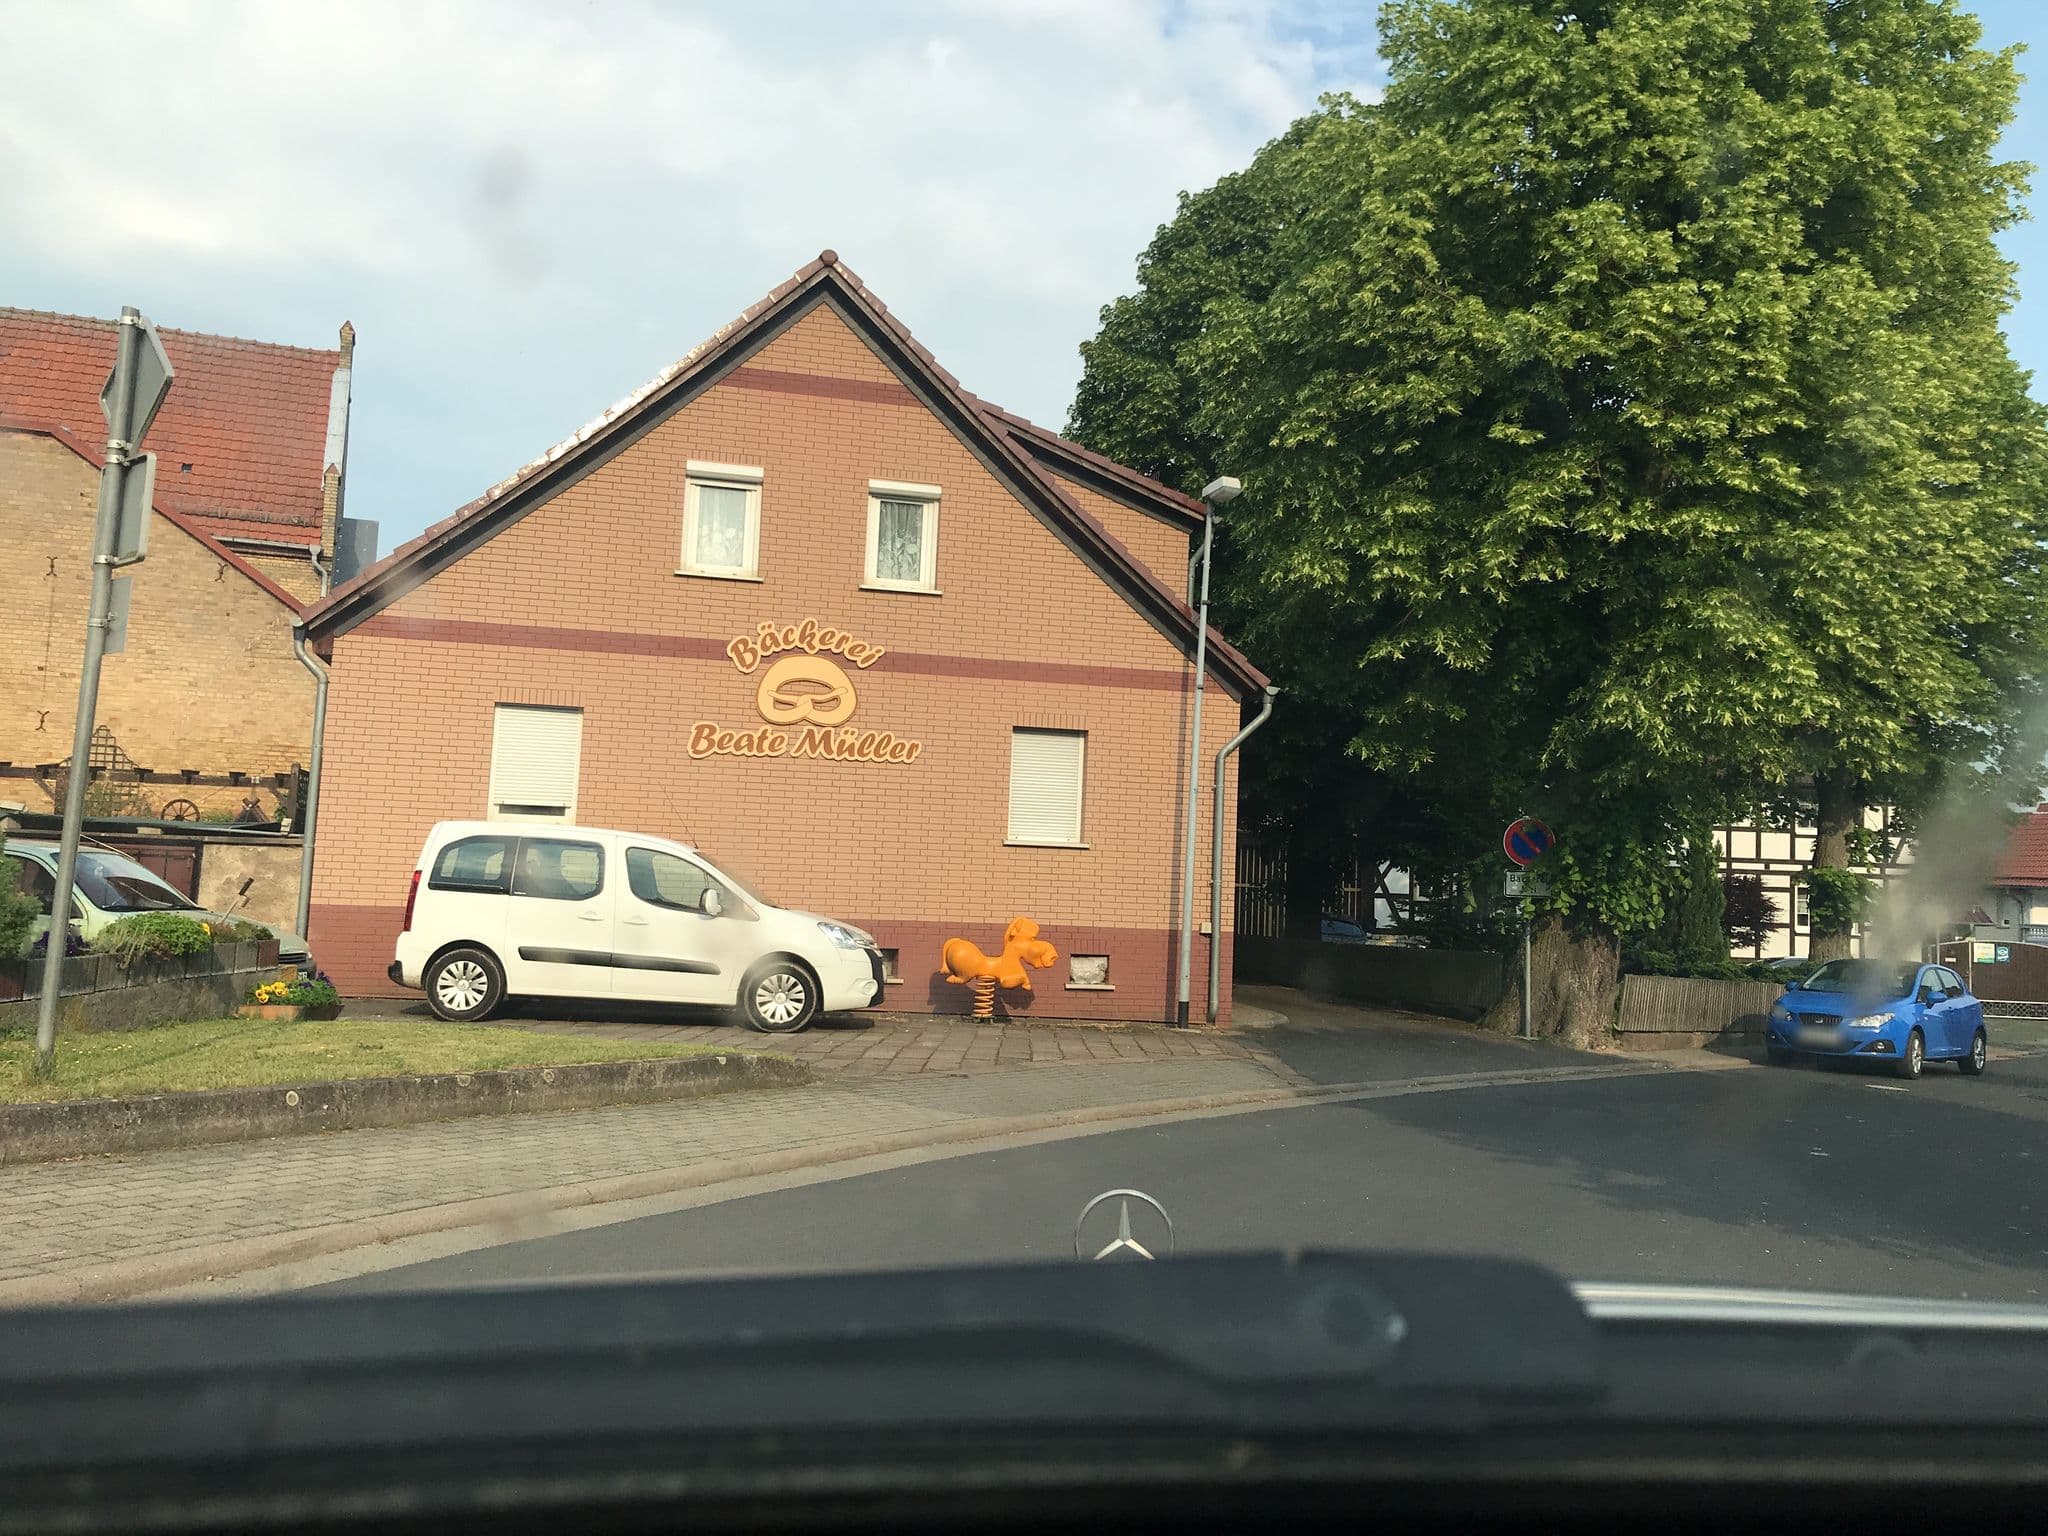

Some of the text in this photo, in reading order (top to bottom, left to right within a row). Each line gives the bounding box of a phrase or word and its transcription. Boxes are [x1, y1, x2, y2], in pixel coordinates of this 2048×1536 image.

[728, 618, 884, 672] Bäckerei
[689, 721, 920, 762] Beate Müller
